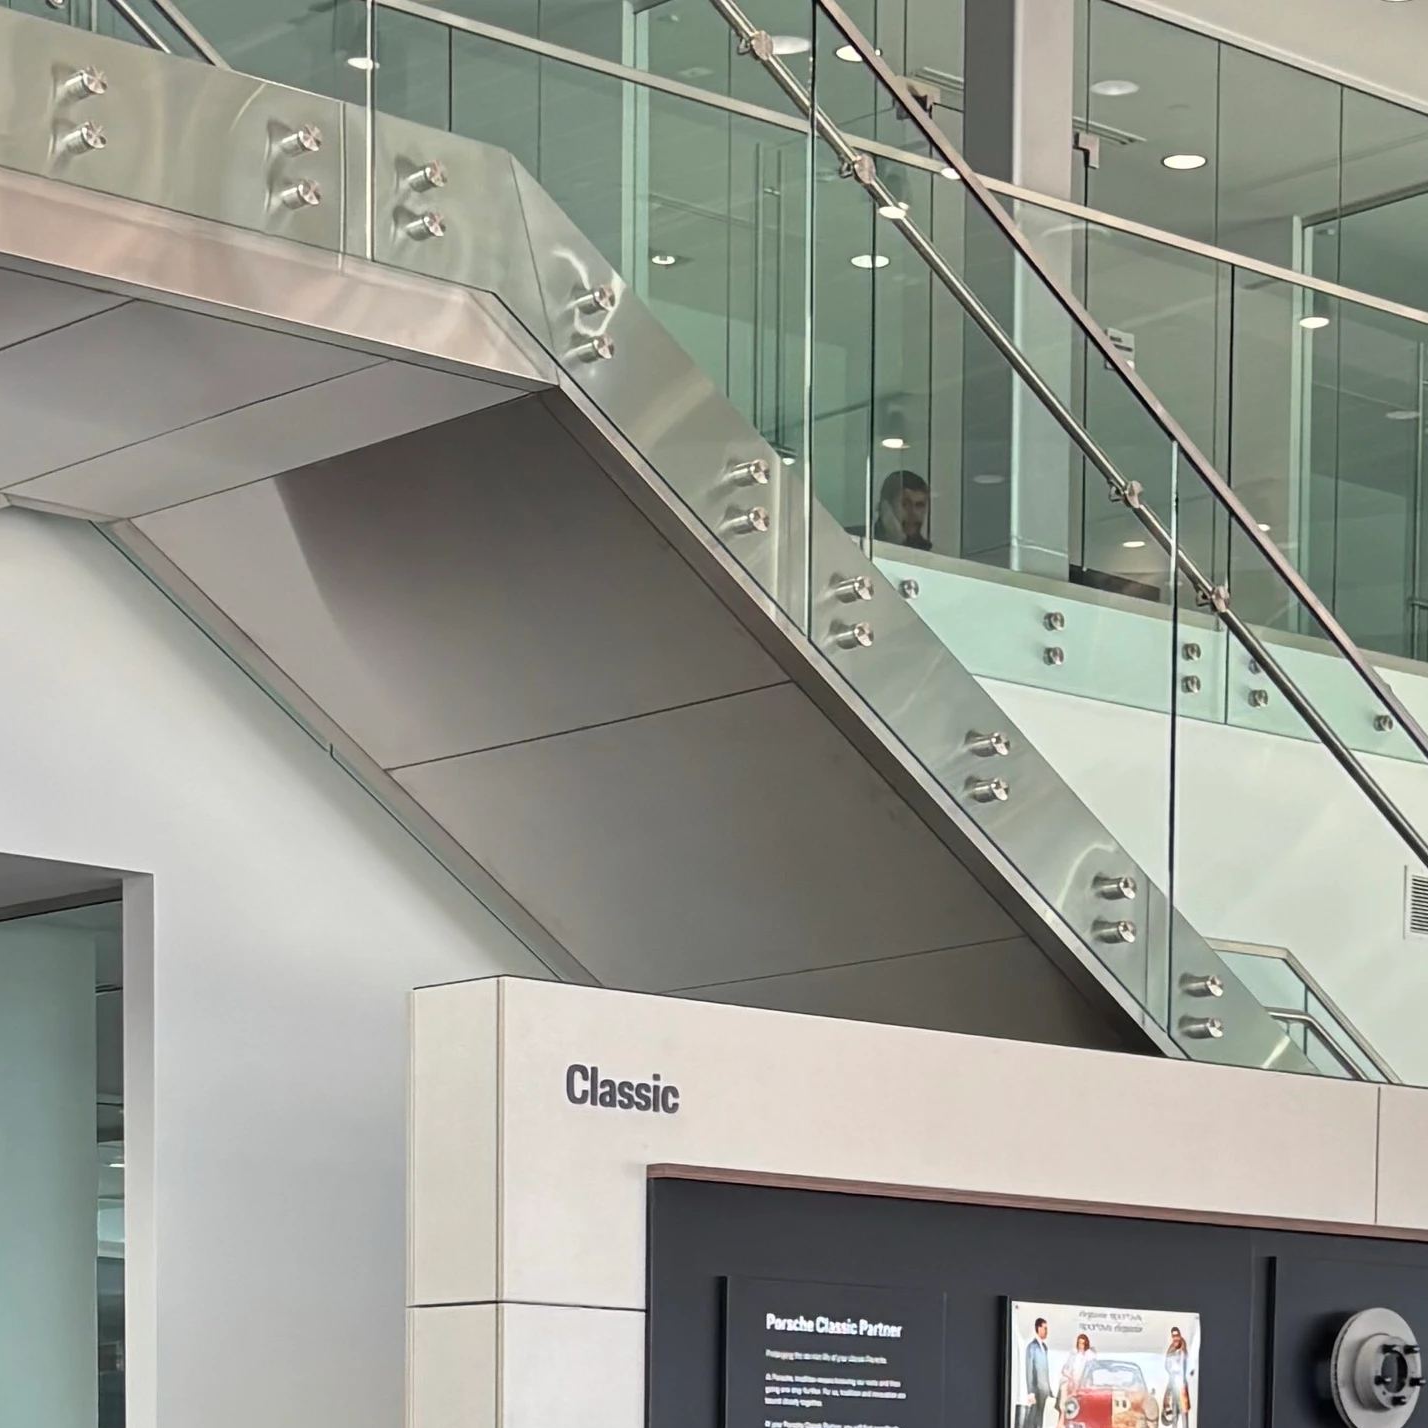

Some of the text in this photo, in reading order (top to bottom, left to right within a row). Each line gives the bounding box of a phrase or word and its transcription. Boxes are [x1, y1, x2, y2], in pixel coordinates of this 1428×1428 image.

[566, 1064, 680, 1114] Classic
[765, 1313, 903, 1338] Porsche Classic Partner
